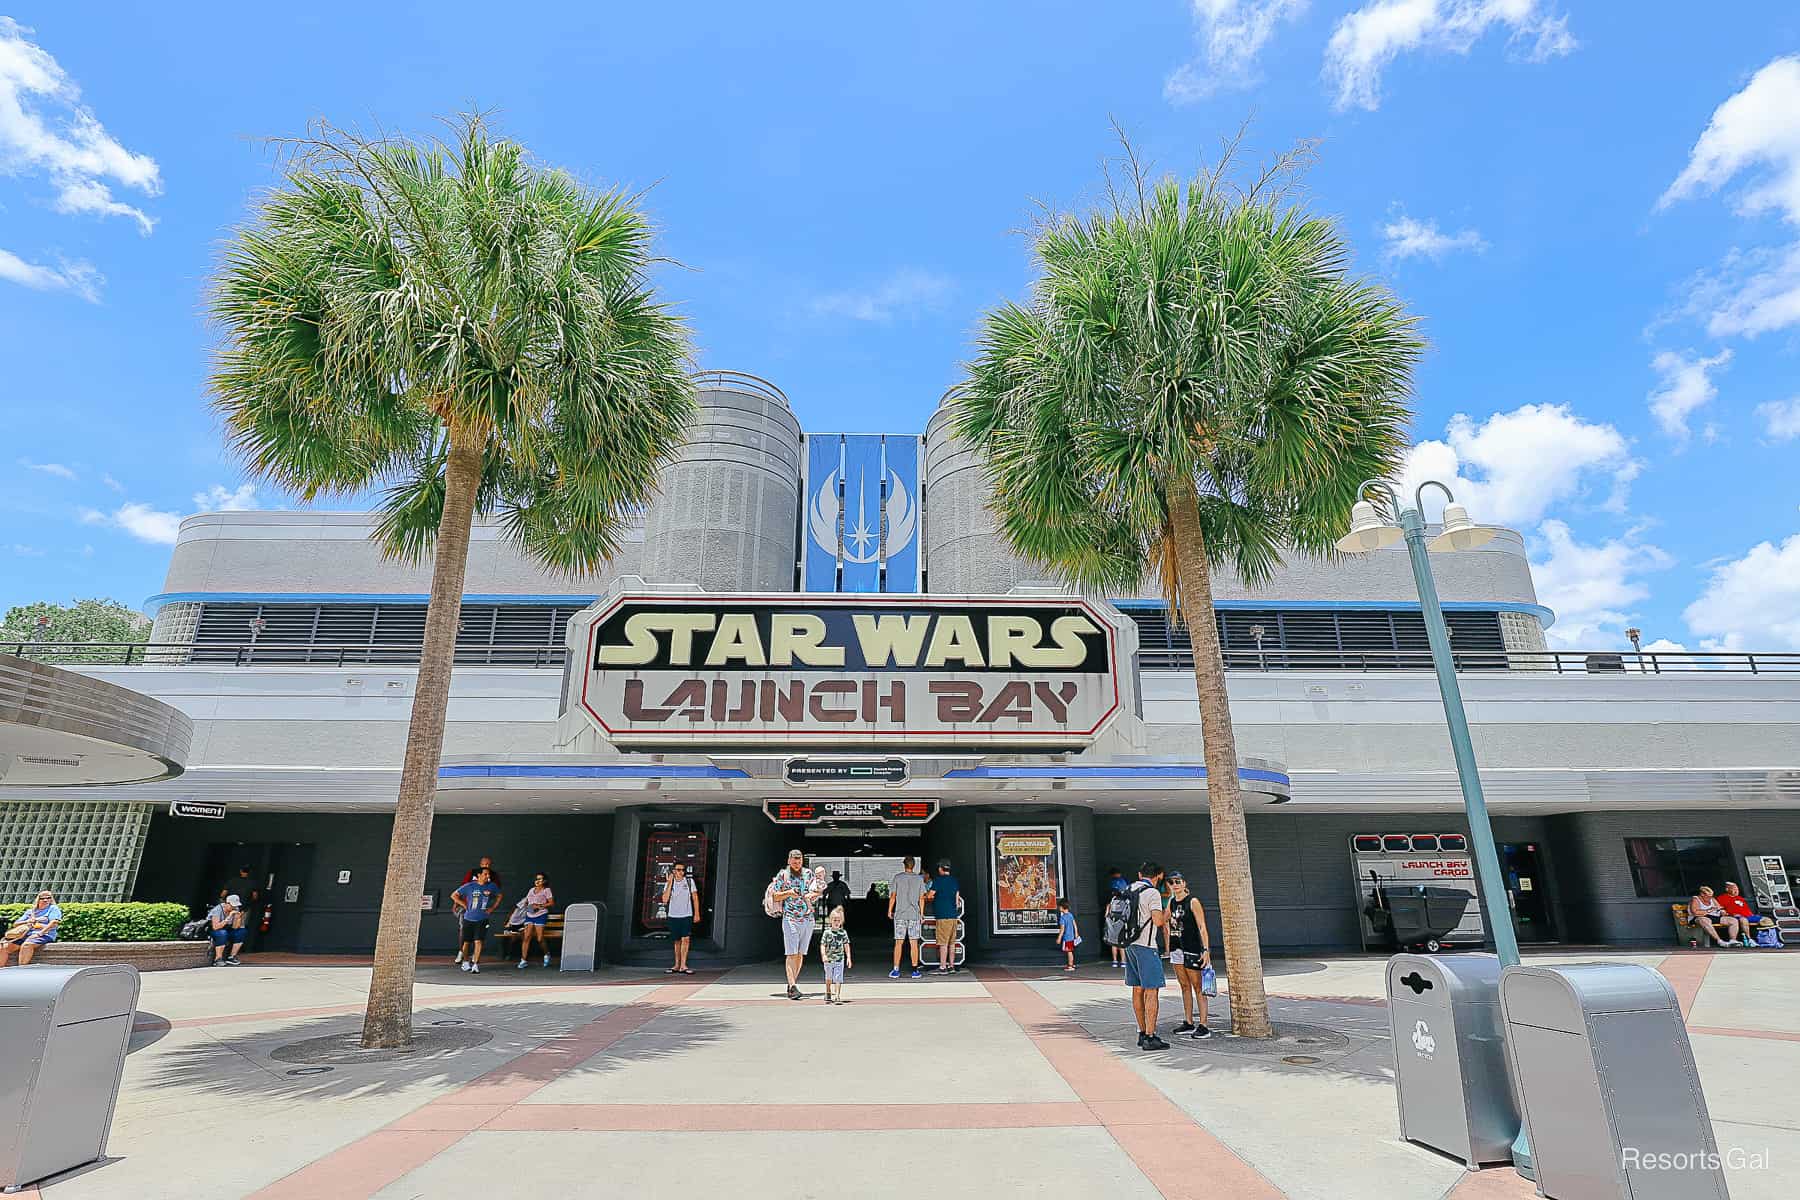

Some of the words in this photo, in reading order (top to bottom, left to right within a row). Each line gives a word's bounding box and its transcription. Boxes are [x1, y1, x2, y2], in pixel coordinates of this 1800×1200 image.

[599, 612, 846, 667] STAR
[851, 612, 1104, 668] WARS
[622, 679, 906, 723] LAUNCH
[929, 679, 1079, 723] BAY
